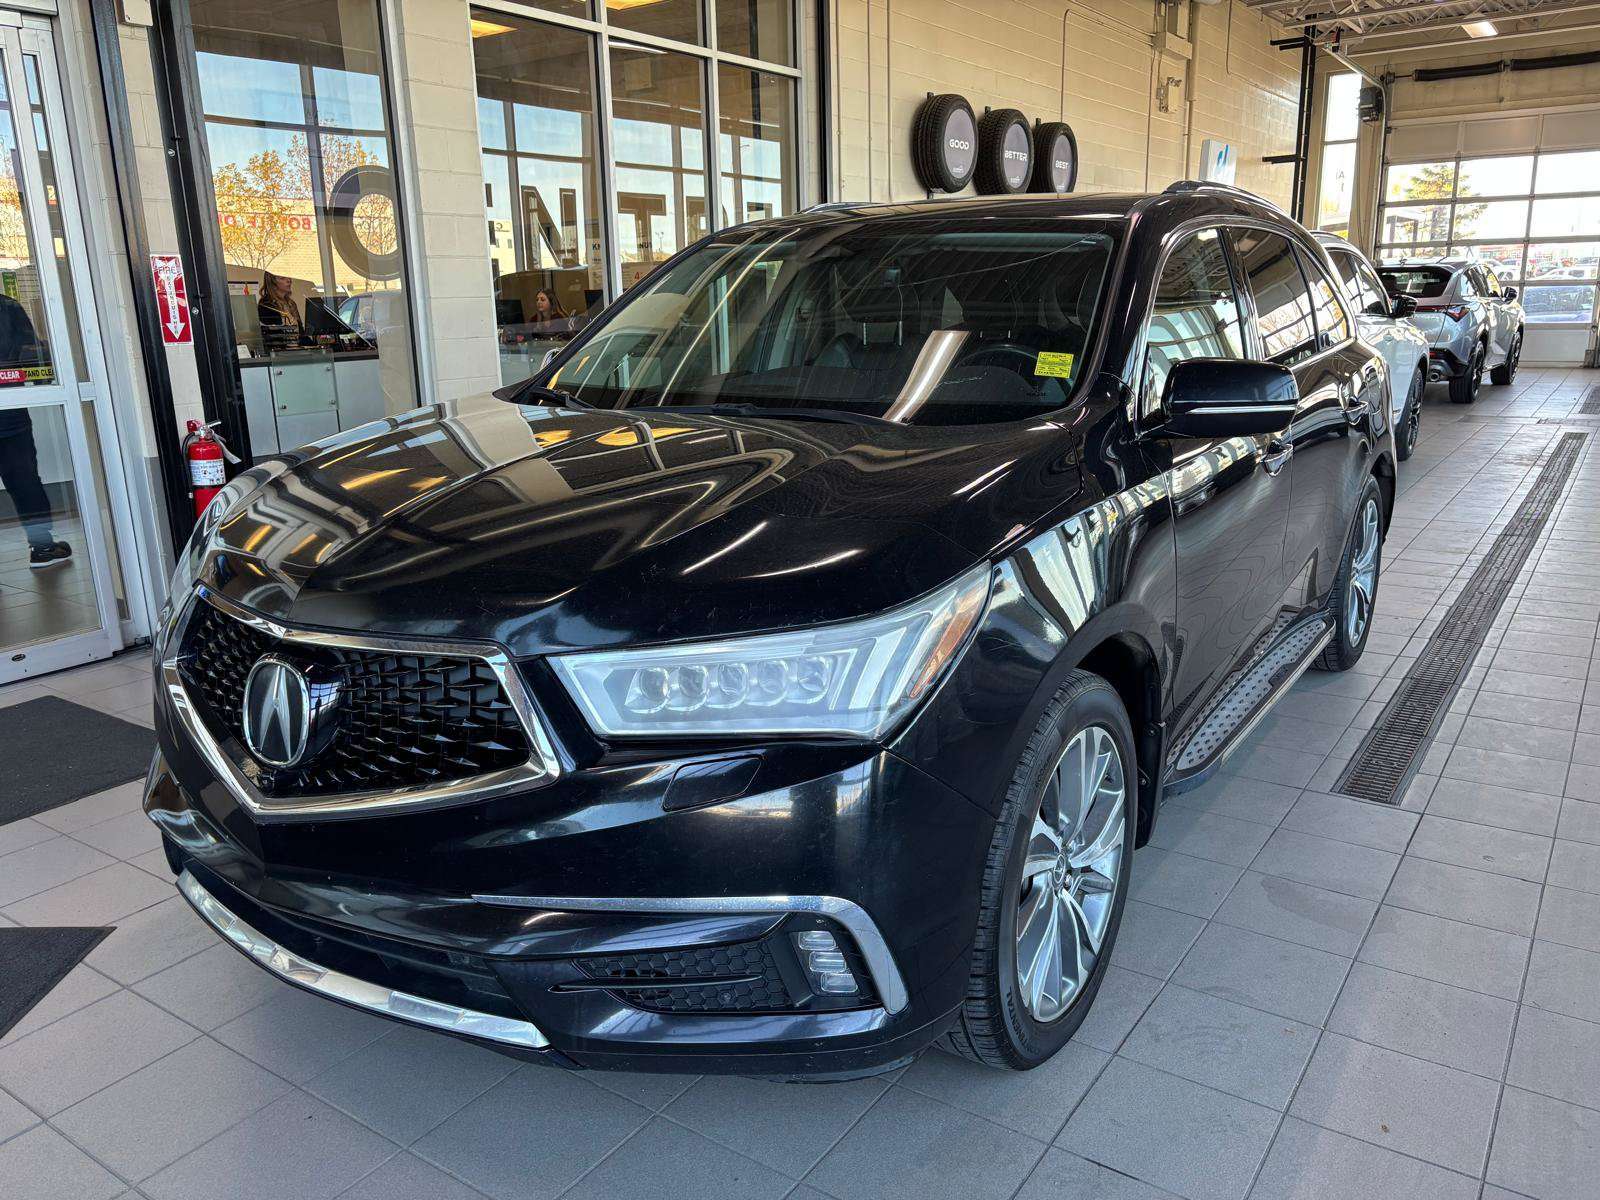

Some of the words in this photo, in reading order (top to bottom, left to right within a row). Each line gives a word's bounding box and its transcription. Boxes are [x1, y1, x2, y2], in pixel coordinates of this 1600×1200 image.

[949, 138, 970, 150] GOOD
[1004, 150, 1028, 162] BETTER
[1055, 159, 1069, 169] BEST
[158, 265, 177, 275] FIRE
[0, 370, 20, 380] CLEAR
